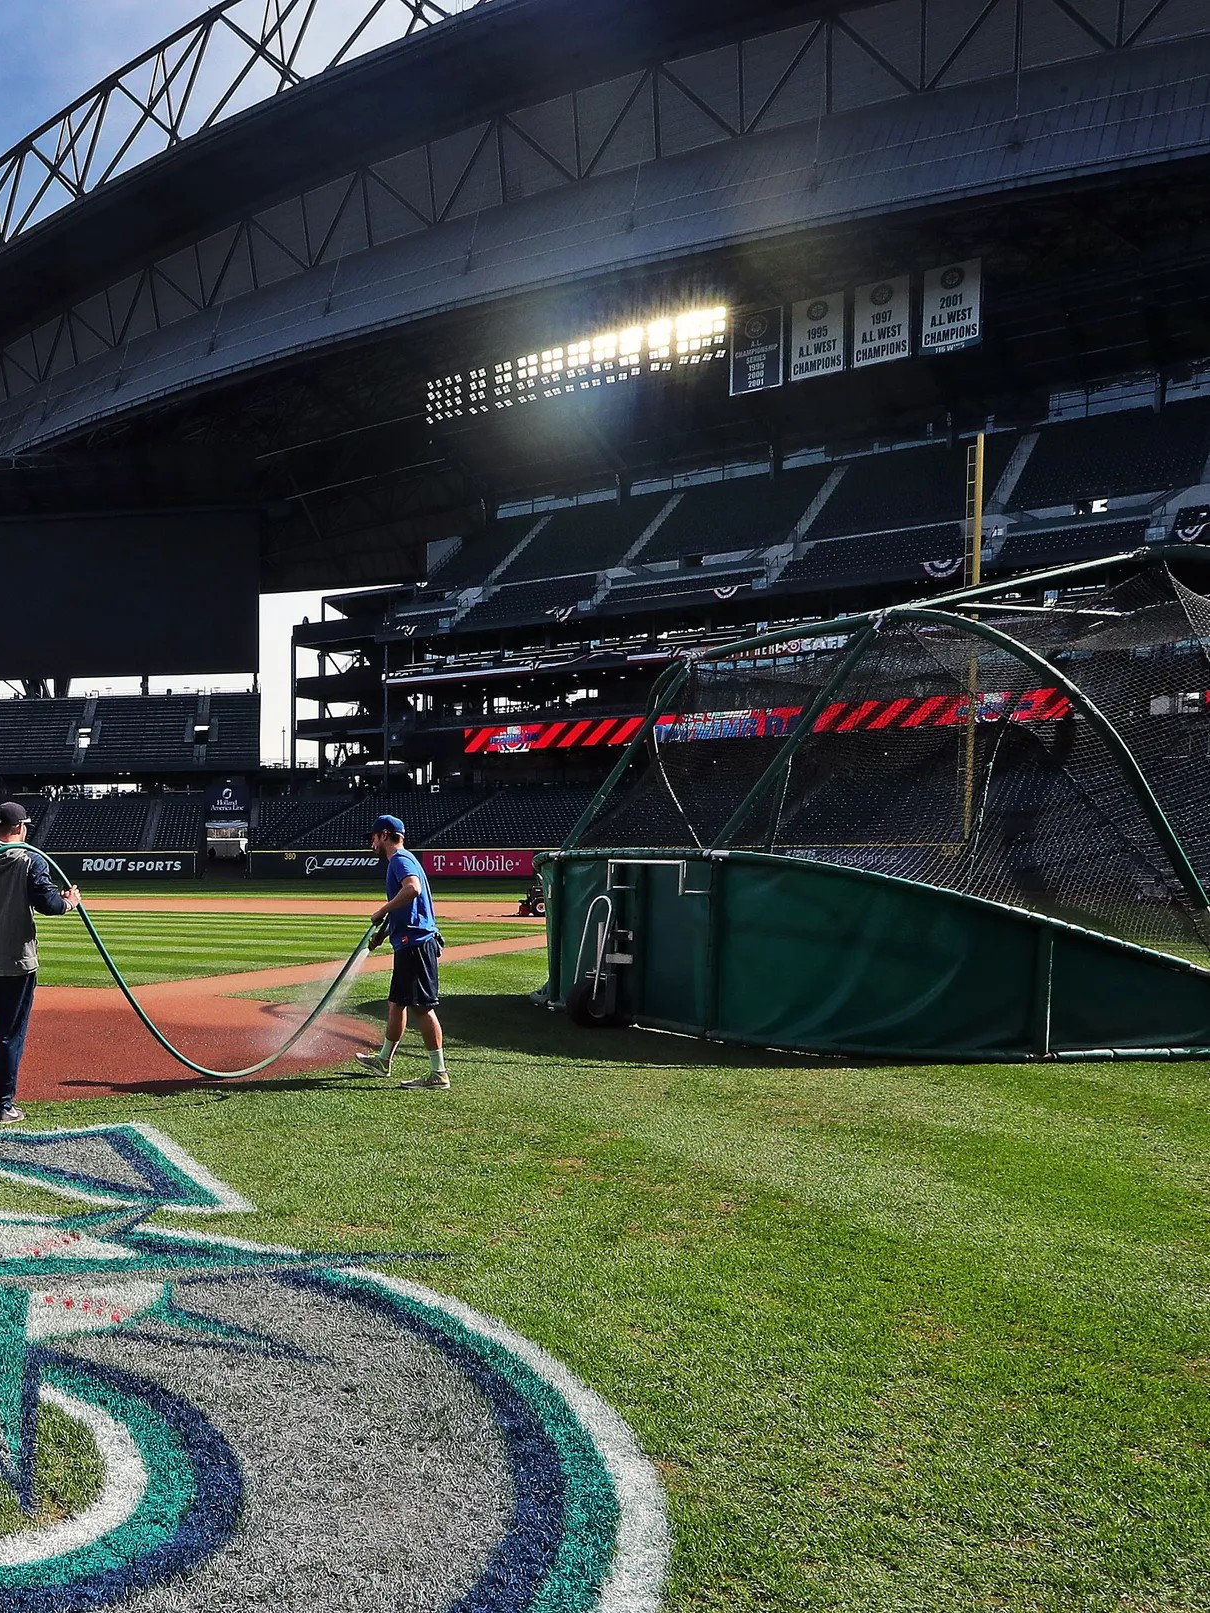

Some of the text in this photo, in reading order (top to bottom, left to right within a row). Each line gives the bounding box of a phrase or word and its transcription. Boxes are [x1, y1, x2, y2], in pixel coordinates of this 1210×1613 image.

[939, 293, 963, 310] 2001
[870, 310, 893, 326] 1997
[930, 307, 973, 328] A.L. WEST
[806, 325, 828, 339] 1995
[861, 324, 902, 345] A.L. WEST
[923, 322, 978, 346] CHAMPIONS
[798, 338, 837, 358] A.L. WEST
[855, 339, 908, 363] CHAMPIONS
[748, 362, 765, 371] 1995
[793, 354, 842, 376] CHAMPIONS
[747, 370, 765, 380] 2000
[747, 378, 764, 388] 2001
[82, 858, 182, 872] ROOT SPORTS
[322, 857, 380, 867] BOEING
